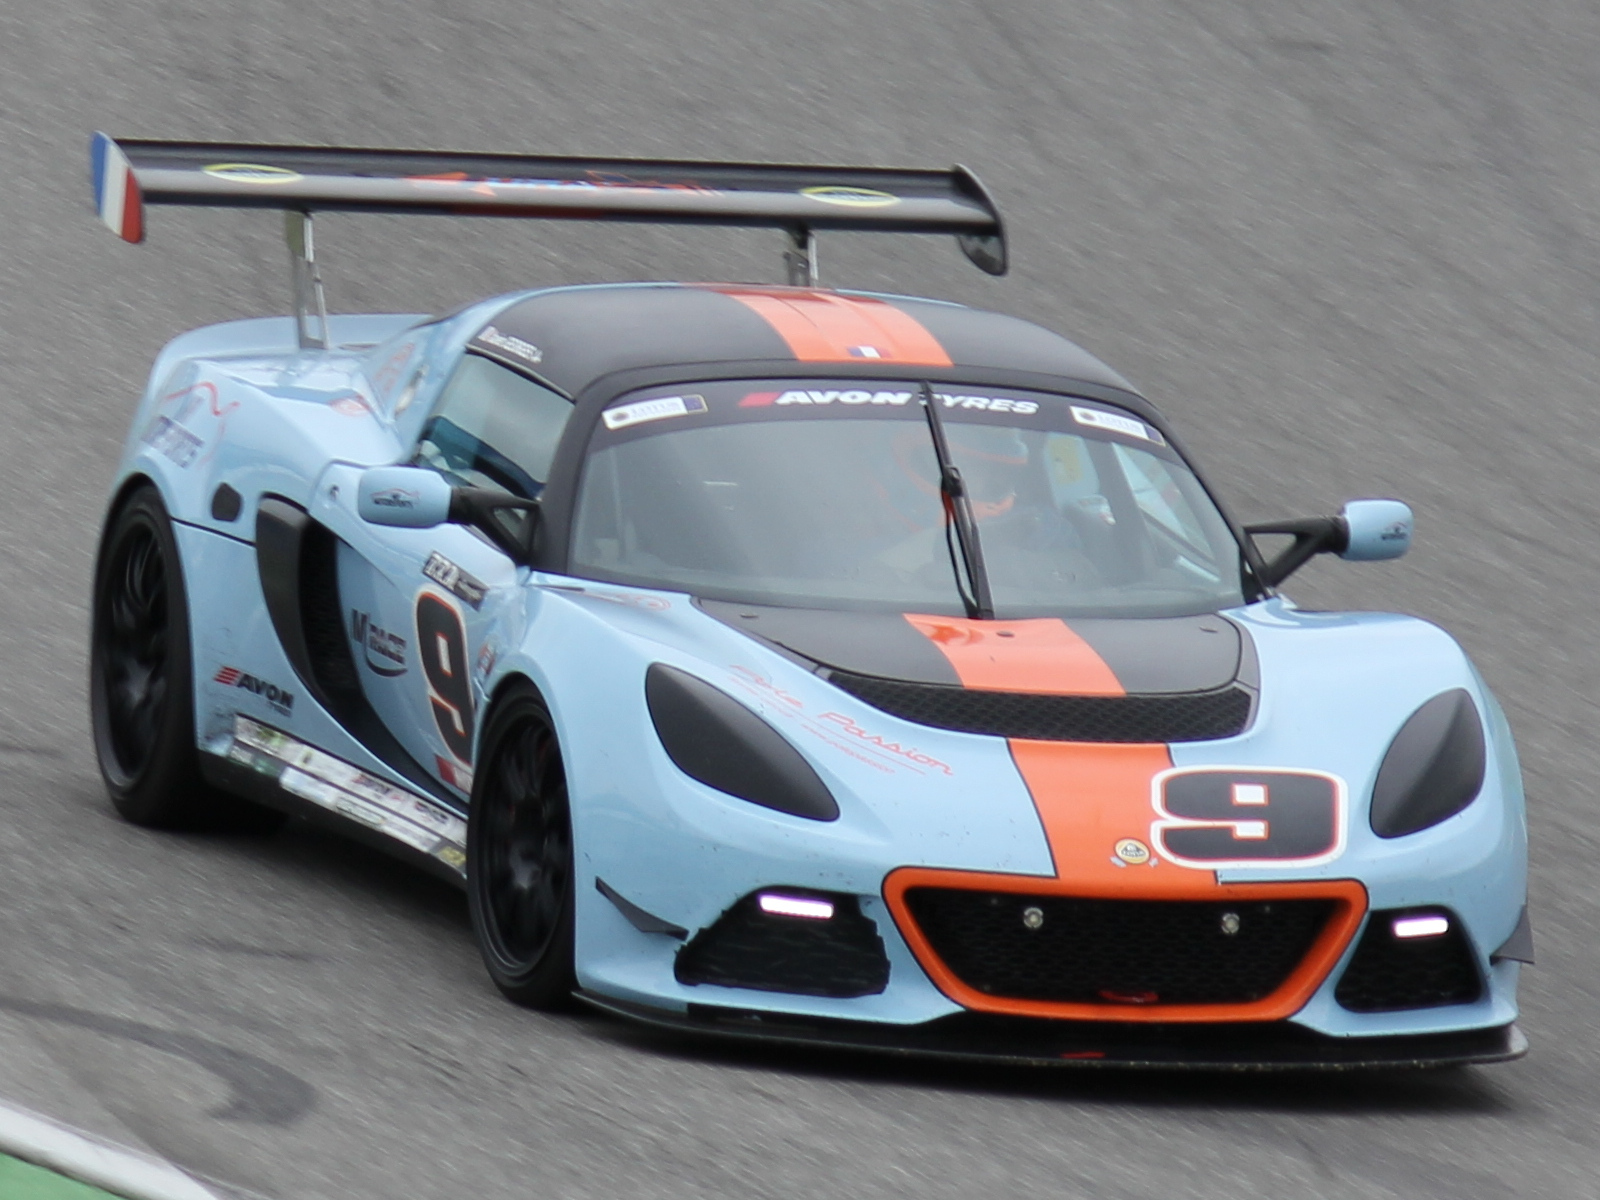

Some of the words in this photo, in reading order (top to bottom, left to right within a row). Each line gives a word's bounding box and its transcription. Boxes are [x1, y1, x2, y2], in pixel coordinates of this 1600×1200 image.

[774, 390, 912, 406] AVON
[237, 673, 294, 710] AVON
[415, 586, 474, 771] 9
[818, 711, 954, 775] Passion
[1153, 766, 1345, 868] 9
